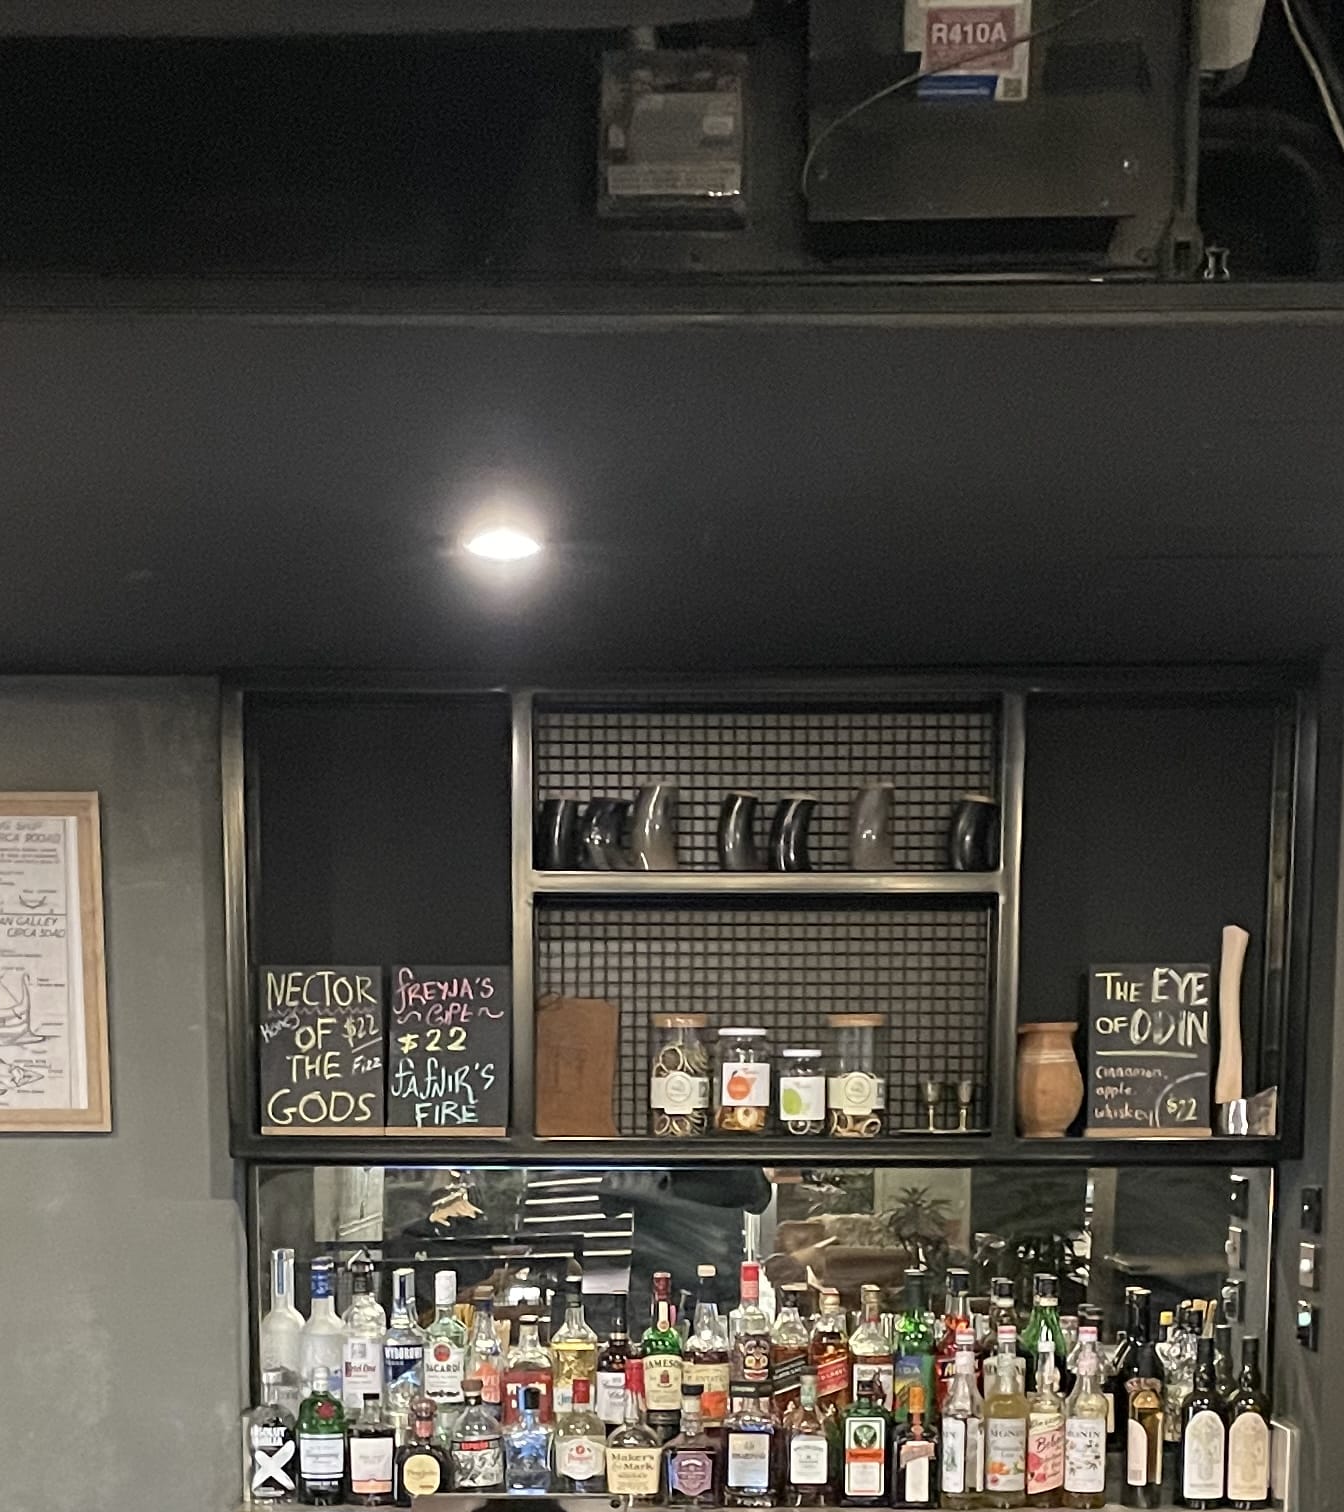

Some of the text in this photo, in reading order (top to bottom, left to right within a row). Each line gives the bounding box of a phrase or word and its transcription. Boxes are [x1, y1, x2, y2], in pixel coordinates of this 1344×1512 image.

[931, 21, 1007, 45] R410A
[6, 927, 37, 938] CIRCA
[15, 917, 58, 927] GALLEY
[267, 971, 378, 1011] NECTOR
[1151, 967, 1209, 1006] EYE
[295, 1017, 337, 1052] OF
[342, 1014, 379, 1048] $22
[1095, 1008, 1208, 1047] OF ODIN
[286, 1051, 343, 1083] THE
[267, 1088, 377, 1124] GODS
[415, 1101, 479, 1127] FIRE
[1094, 1093, 1198, 1127] whiskey $22
